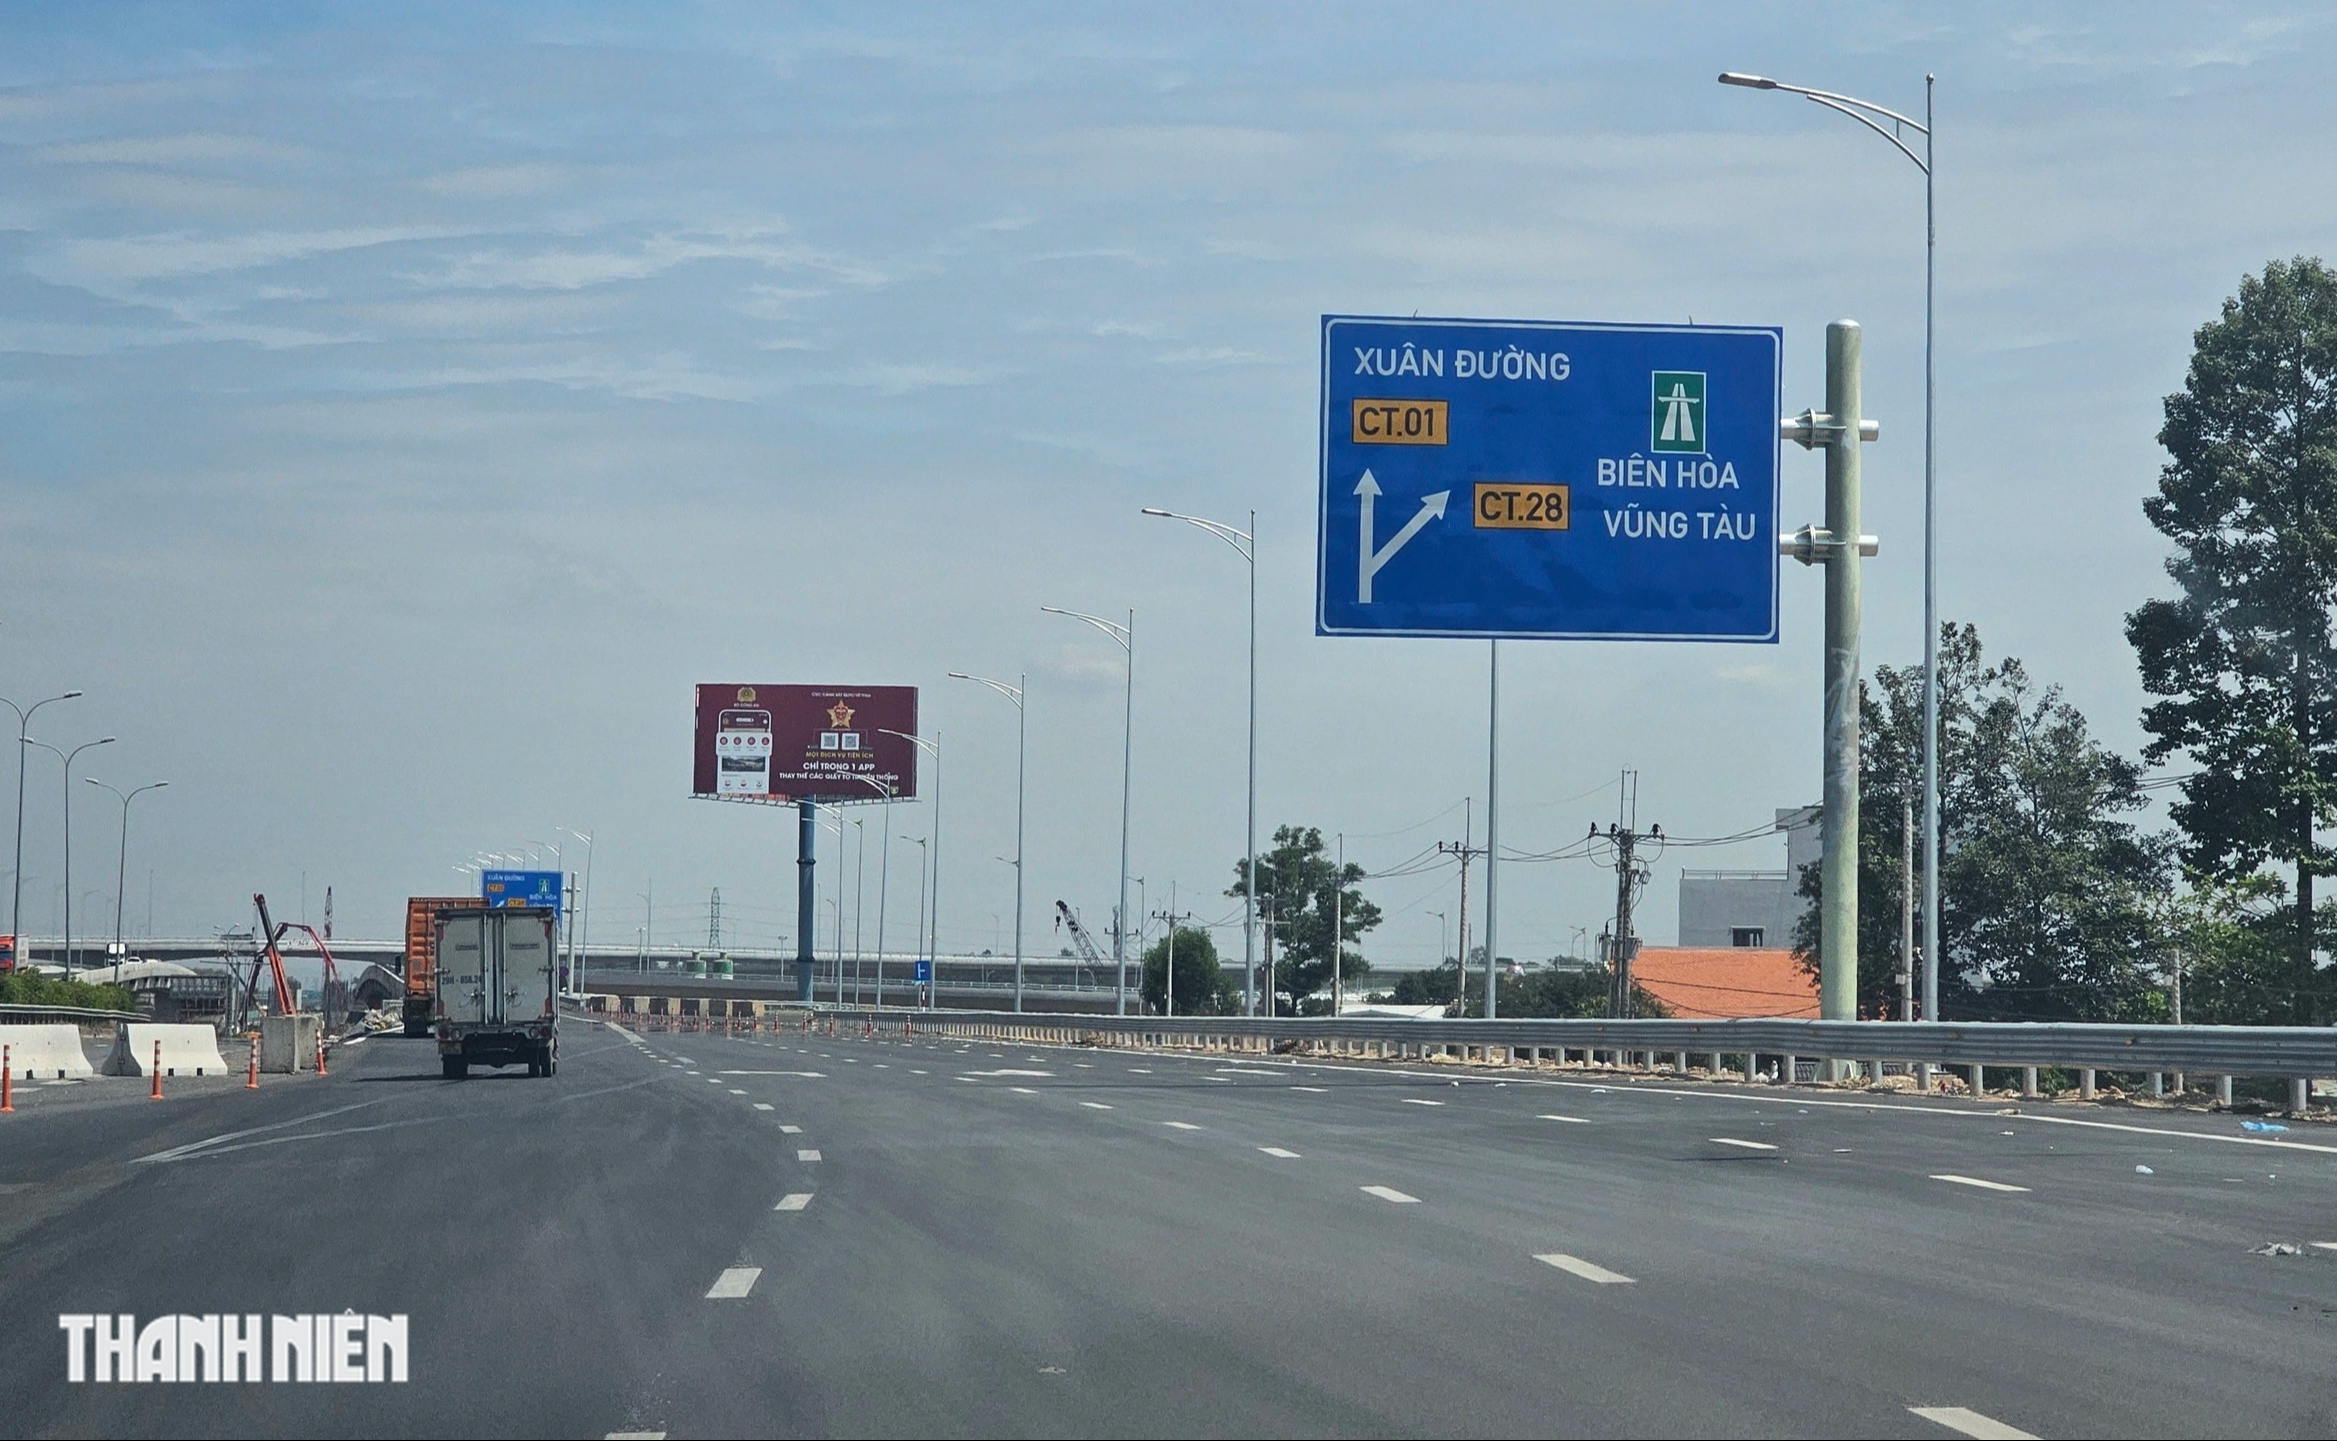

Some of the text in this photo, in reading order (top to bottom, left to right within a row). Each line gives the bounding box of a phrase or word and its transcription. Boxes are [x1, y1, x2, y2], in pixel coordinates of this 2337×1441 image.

[1354, 342, 1571, 381] XUÂN ĐƯỜNG
[1358, 407, 1435, 437] CT.01
[1597, 452, 1740, 490] BIÊN HÒA
[1480, 491, 1563, 523] CT.28
[1603, 503, 1756, 541] VŨNG TÀU
[808, 772, 824, 780] CÁC
[820, 763, 850, 771] TRONG
[851, 763, 856, 771] 1
[858, 763, 876, 771] APP
